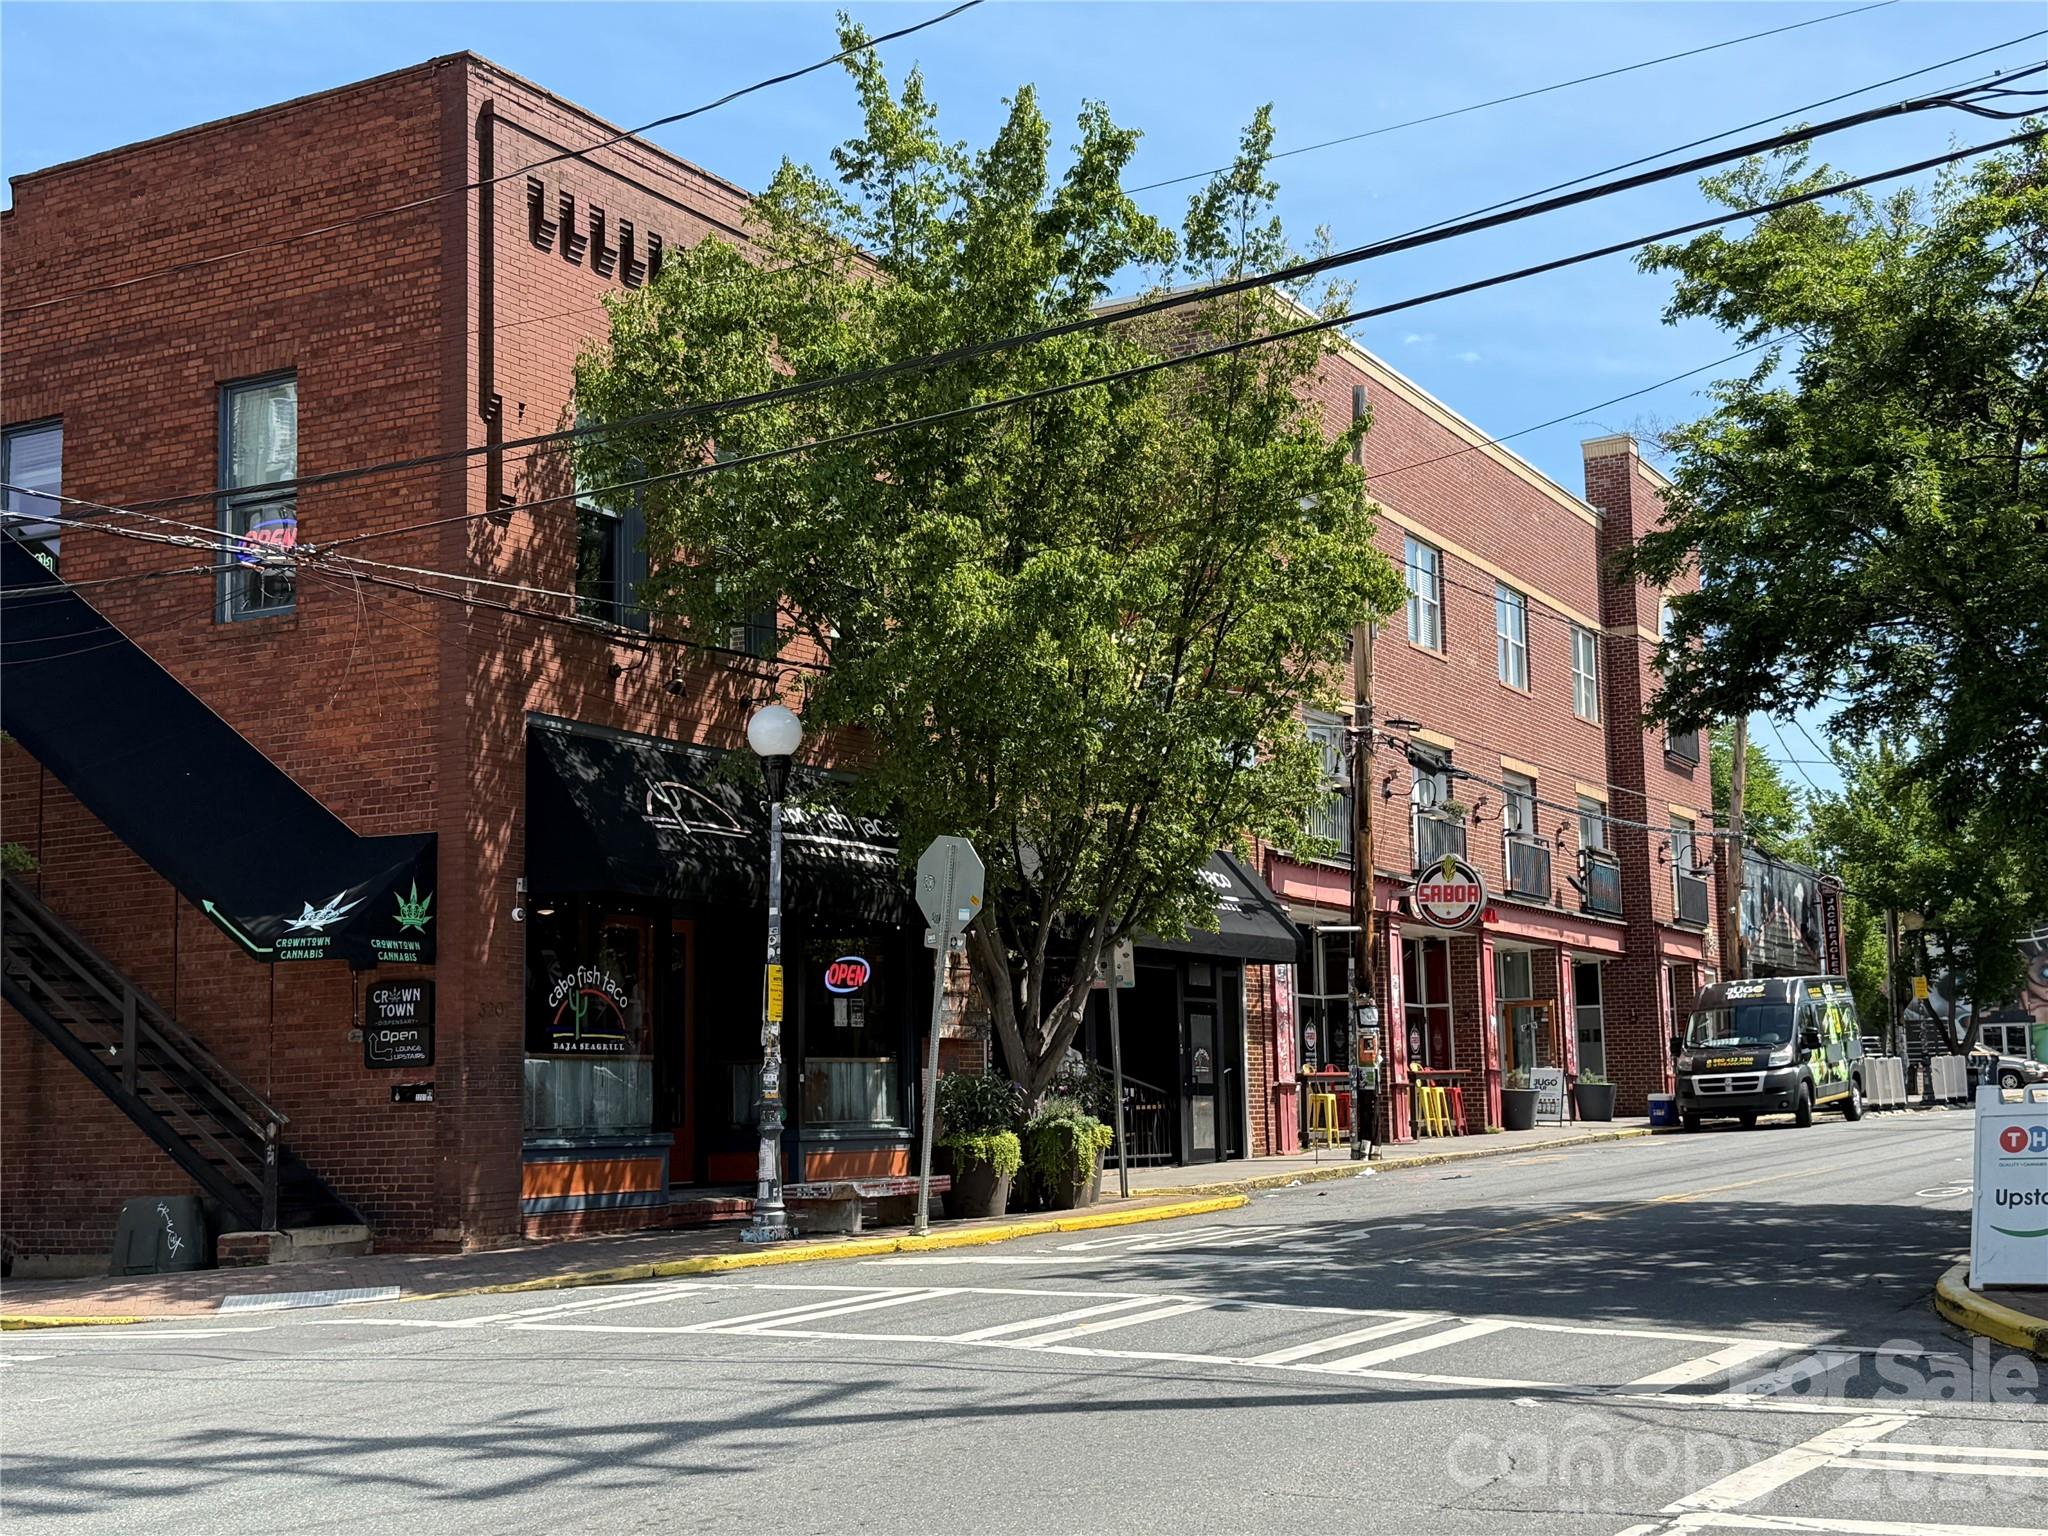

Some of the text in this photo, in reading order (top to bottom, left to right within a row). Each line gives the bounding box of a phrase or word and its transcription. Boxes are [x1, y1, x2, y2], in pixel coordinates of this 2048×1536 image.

[276, 937, 331, 948] CROWNTOWN
[371, 939, 421, 950] CROWNTOWN
[280, 949, 324, 960] CANNABIS
[377, 951, 418, 962] CANNABIS
[828, 963, 866, 986] OPEN
[548, 965, 628, 1008] cabo fish taco
[373, 987, 421, 1003] CRWN
[379, 1003, 415, 1018] TOWN
[380, 1030, 418, 1043] Open
[395, 1045, 422, 1053] LOUNGE
[553, 1042, 625, 1051] BAJA SEAGRILL
[1533, 1078, 1558, 1086] JUGO
